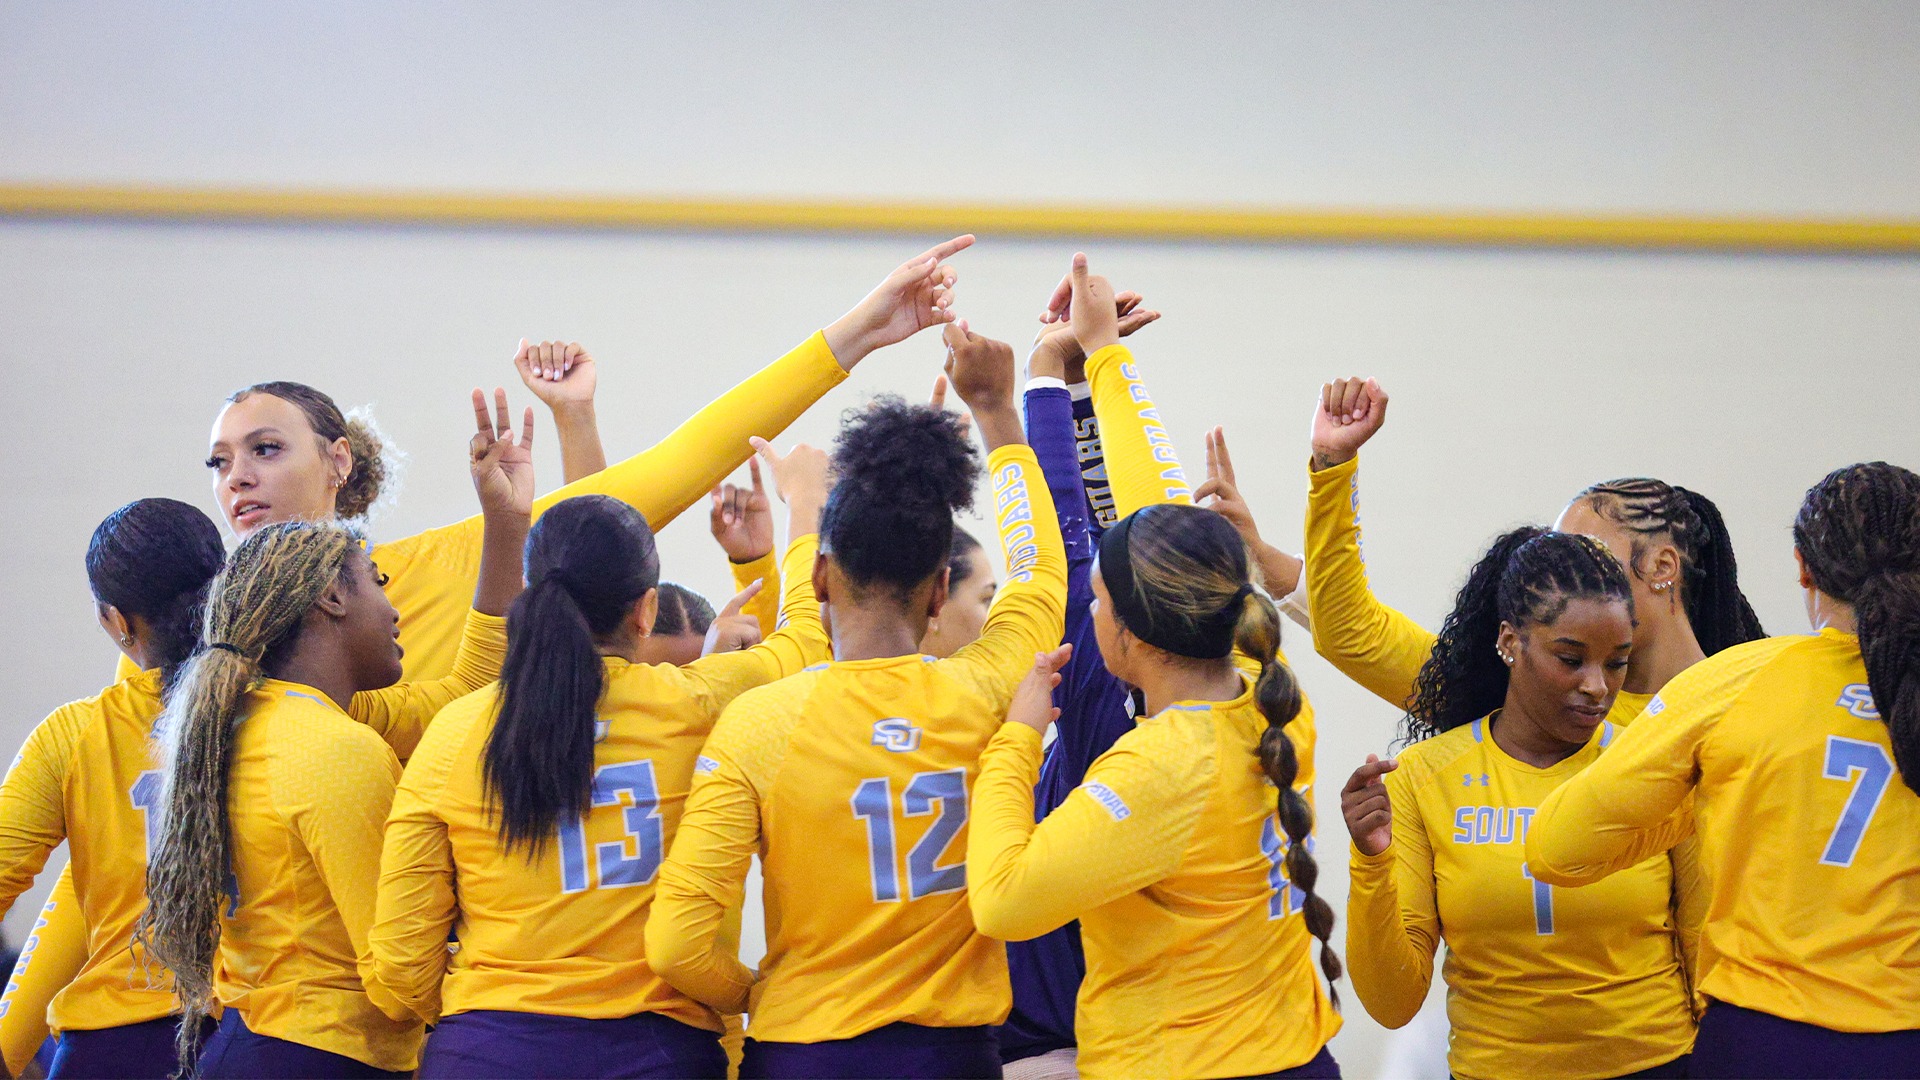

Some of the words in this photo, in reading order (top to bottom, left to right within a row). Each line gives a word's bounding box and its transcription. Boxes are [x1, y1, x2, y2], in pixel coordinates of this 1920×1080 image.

[1074, 416, 1119, 529] GUARS
[1120, 363, 1192, 499] JAGUARS
[871, 717, 923, 752] SU
[556, 758, 663, 893] 13
[850, 767, 968, 903] 12
[1087, 783, 1131, 820] SWAC
[1453, 805, 1537, 845] SOUT
[1818, 734, 1896, 868] 7
[1521, 861, 1554, 936] 1
